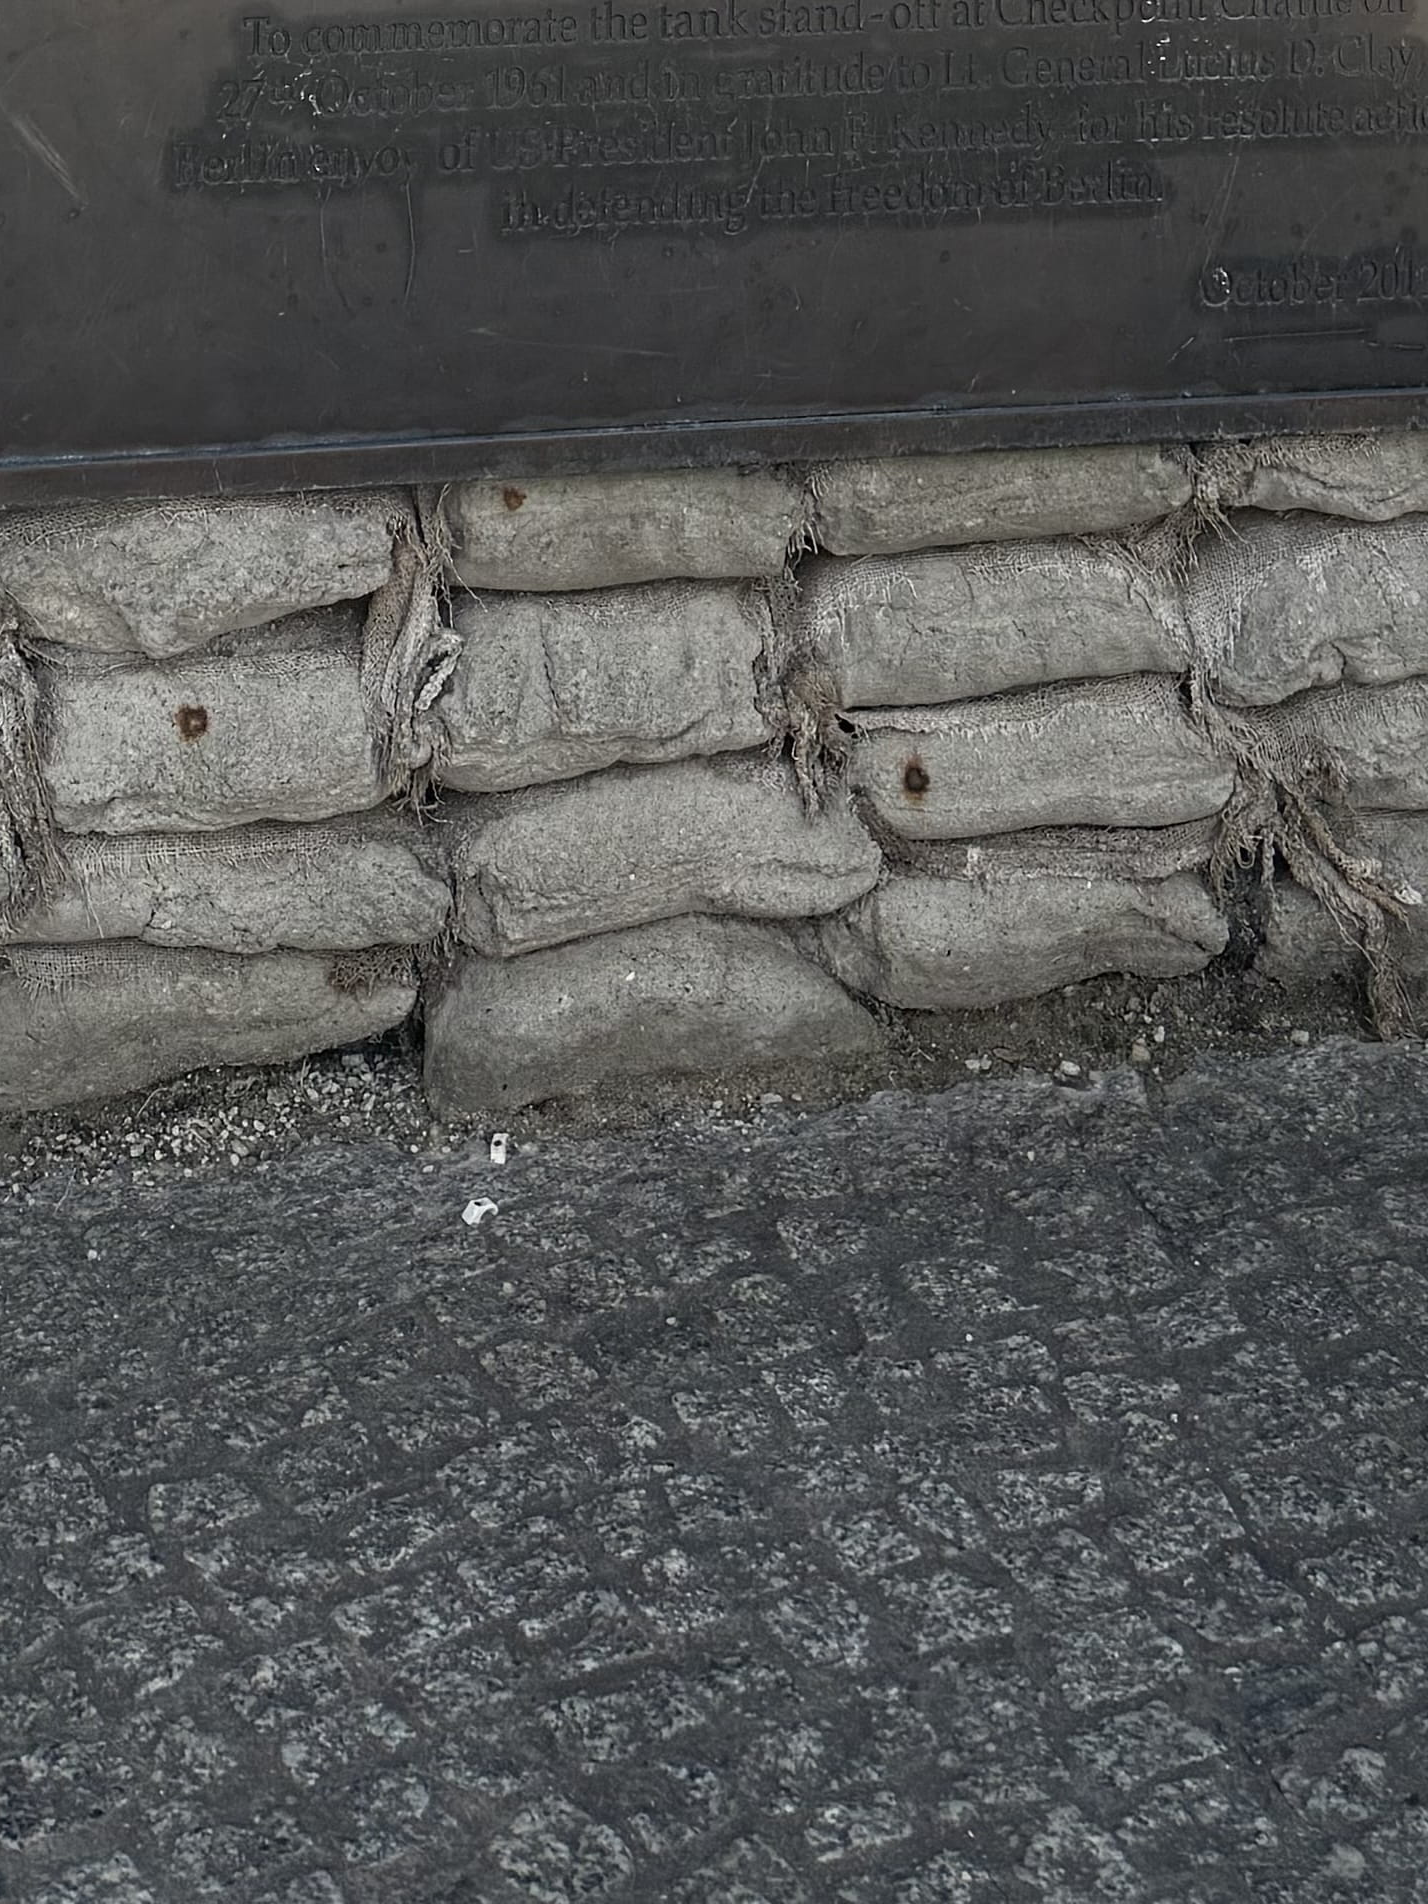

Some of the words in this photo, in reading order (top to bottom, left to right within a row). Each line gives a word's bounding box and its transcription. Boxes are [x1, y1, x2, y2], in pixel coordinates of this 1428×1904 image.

[242, 15, 292, 57] To
[301, 9, 578, 55] commemorate
[590, 1, 649, 43] the
[310, 67, 474, 118] October
[485, 65, 567, 110] 1961
[583, 59, 651, 104] and
[897, 55, 931, 92] to
[1001, 41, 1146, 91] General
[1158, 44, 1276, 82] Lucius
[1286, 38, 1324, 79] D.
[1333, 33, 1427, 85] Clay,
[175, 140, 299, 186] Berlin
[312, 140, 413, 188] envoy
[438, 128, 477, 174] of
[487, 130, 548, 171] US
[553, 116, 733, 167] President
[1077, 104, 1126, 144] for
[1134, 101, 1194, 143] his
[1203, 96, 1345, 139] resolute
[1200, 259, 1345, 308] October
